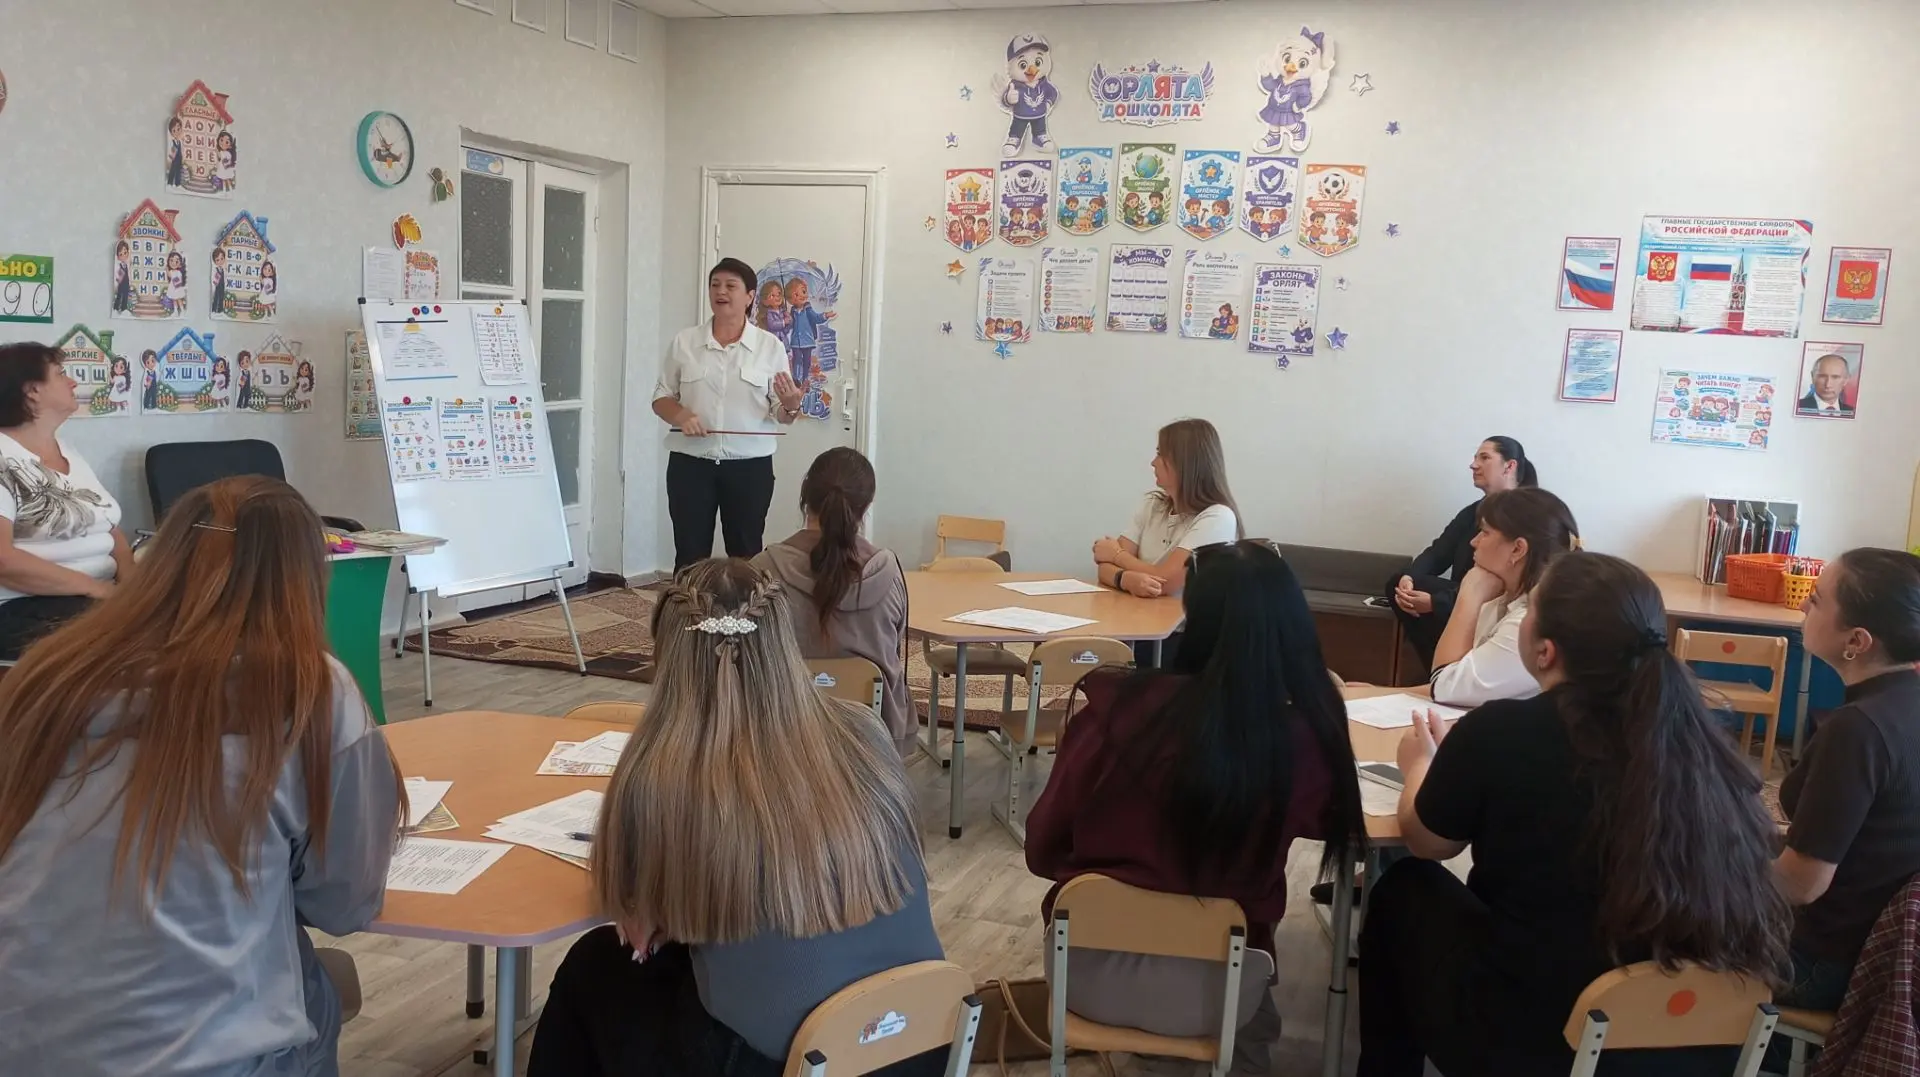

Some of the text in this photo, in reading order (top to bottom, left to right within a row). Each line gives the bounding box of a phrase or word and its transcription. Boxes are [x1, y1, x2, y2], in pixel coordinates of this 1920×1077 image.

[1101, 75, 1203, 100] ОРЛЯТА
[185, 106, 216, 119] ГЛАСНЫЕ
[1102, 104, 1202, 118] ДОШКОЛЯТА
[185, 120, 215, 132] А О У
[185, 135, 215, 148] Э Ы И
[185, 149, 192, 159] Я
[197, 151, 203, 160] Е
[196, 166, 205, 175] Ю
[133, 228, 165, 237] ЗВОНКИЕ
[1664, 225, 1788, 236] РОССИЙСКОЙ ФЕДЕРАЦИИ
[132, 241, 165, 252] Б В Г
[232, 236, 258, 246] ПАРНЫЕ
[133, 256, 164, 267] Д Ж З
[146, 271, 152, 280] Л
[158, 272, 165, 280] М
[1270, 271, 1306, 280] ЗАКОНЫ
[140, 285, 158, 294] Н Р
[1272, 280, 1302, 288] ОРЛЯТ
[64, 351, 98, 359] МЯГКИЕ
[76, 369, 106, 382] Ч Щ
[165, 368, 207, 381] Ж Ш Ц
